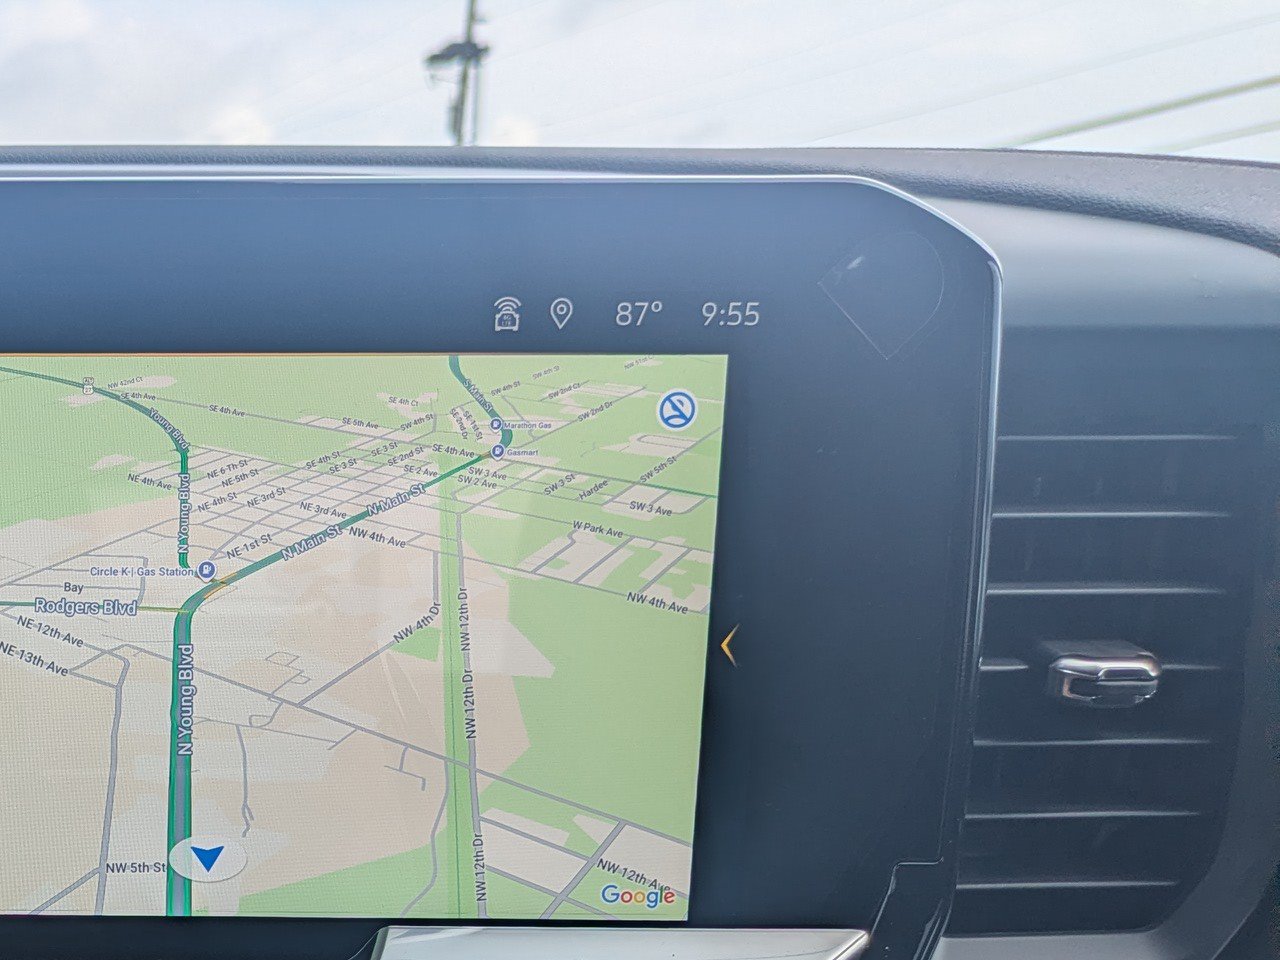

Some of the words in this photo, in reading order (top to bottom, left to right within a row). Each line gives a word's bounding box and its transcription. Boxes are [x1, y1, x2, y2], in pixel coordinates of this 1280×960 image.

[616, 301, 662, 326] 87°
[702, 302, 759, 326] 9:55
[220, 406, 231, 414] 4th
[232, 408, 245, 417] Ave
[149, 408, 173, 432] Young
[171, 430, 189, 449] Blvd
[342, 417, 352, 425] SE
[365, 421, 378, 429] Ave
[306, 461, 317, 470] SE
[318, 454, 331, 466] 4th
[332, 450, 341, 459] St
[387, 457, 399, 467] SE
[400, 451, 414, 462] 2nd
[415, 446, 424, 455] St
[432, 444, 443, 452] SE
[444, 444, 457, 455] 4th
[460, 449, 474, 459] Ave
[221, 479, 233, 488] NE
[233, 472, 248, 484] 5th
[249, 468, 259, 477] St
[404, 464, 415, 473] SE
[423, 468, 438, 477] Ave
[468, 466, 483, 476] SW
[491, 472, 507, 480] Ave
[640, 471, 653, 483] SW
[653, 462, 667, 476] 5th
[667, 456, 677, 466] St
[128, 473, 140, 482] NE
[157, 481, 172, 490] Ave
[178, 474, 190, 500] Blvd
[457, 474, 472, 483] SW
[481, 480, 497, 489] Ave
[579, 479, 608, 500] Hardee
[198, 503, 211, 512] NE
[212, 496, 225, 507] 4th
[227, 491, 237, 501] St
[247, 498, 259, 508] NE
[261, 491, 275, 503] 3rd
[276, 487, 286, 496] St
[367, 504, 378, 516] N
[379, 492, 409, 511] Main
[410, 483, 425, 497] St
[300, 502, 312, 511] NE
[314, 504, 329, 515] 3rd
[330, 510, 347, 519] Ave
[630, 501, 646, 510] SW
[655, 506, 672, 517] Ave
[178, 503, 192, 540] Young
[573, 520, 583, 529] W
[584, 524, 604, 534] Park
[605, 528, 623, 538] Ave
[227, 548, 241, 560] NE
[243, 540, 259, 554] 1st
[260, 533, 272, 545] St
[282, 548, 294, 561] N
[294, 530, 330, 554] Main
[327, 524, 343, 539] St
[349, 527, 367, 538] NW
[370, 531, 385, 543] 4th
[387, 538, 406, 548] Ave
[178, 545, 189, 553] N
[90, 567, 118, 576] Circle
[121, 567, 128, 576] K
[137, 567, 156, 576] Gas
[158, 567, 194, 576] Station
[64, 581, 84, 594] Bay
[458, 588, 467, 600] Dr
[35, 598, 98, 616] Rodgers
[102, 599, 137, 616] Blvd
[626, 592, 645, 605] NW
[647, 596, 666, 609] 4th
[669, 603, 689, 615] Ave
[393, 625, 413, 643] NW
[416, 614, 433, 630] 4th
[429, 601, 441, 616] Dr
[459, 603, 469, 628] 12th
[17, 615, 34, 630] NE
[36, 622, 60, 639] 12th
[62, 633, 84, 648] Ave
[461, 631, 470, 651] NW
[19, 648, 44, 668] 13th
[46, 660, 68, 677] Ave
[179, 644, 193, 681] Blvd
[462, 669, 473, 683] Dr
[463, 686, 474, 714] 12th
[178, 685, 197, 738] Young
[466, 718, 476, 739] NW
[178, 742, 193, 755] N
[473, 833, 483, 847] Dr
[106, 863, 128, 873] NW
[130, 863, 150, 873] 5th
[154, 863, 166, 873] St
[474, 849, 485, 877] 12th
[597, 858, 618, 874] NW
[621, 868, 648, 887] 12th
[476, 880, 487, 901] NW
[601, 884, 675, 908] Google
